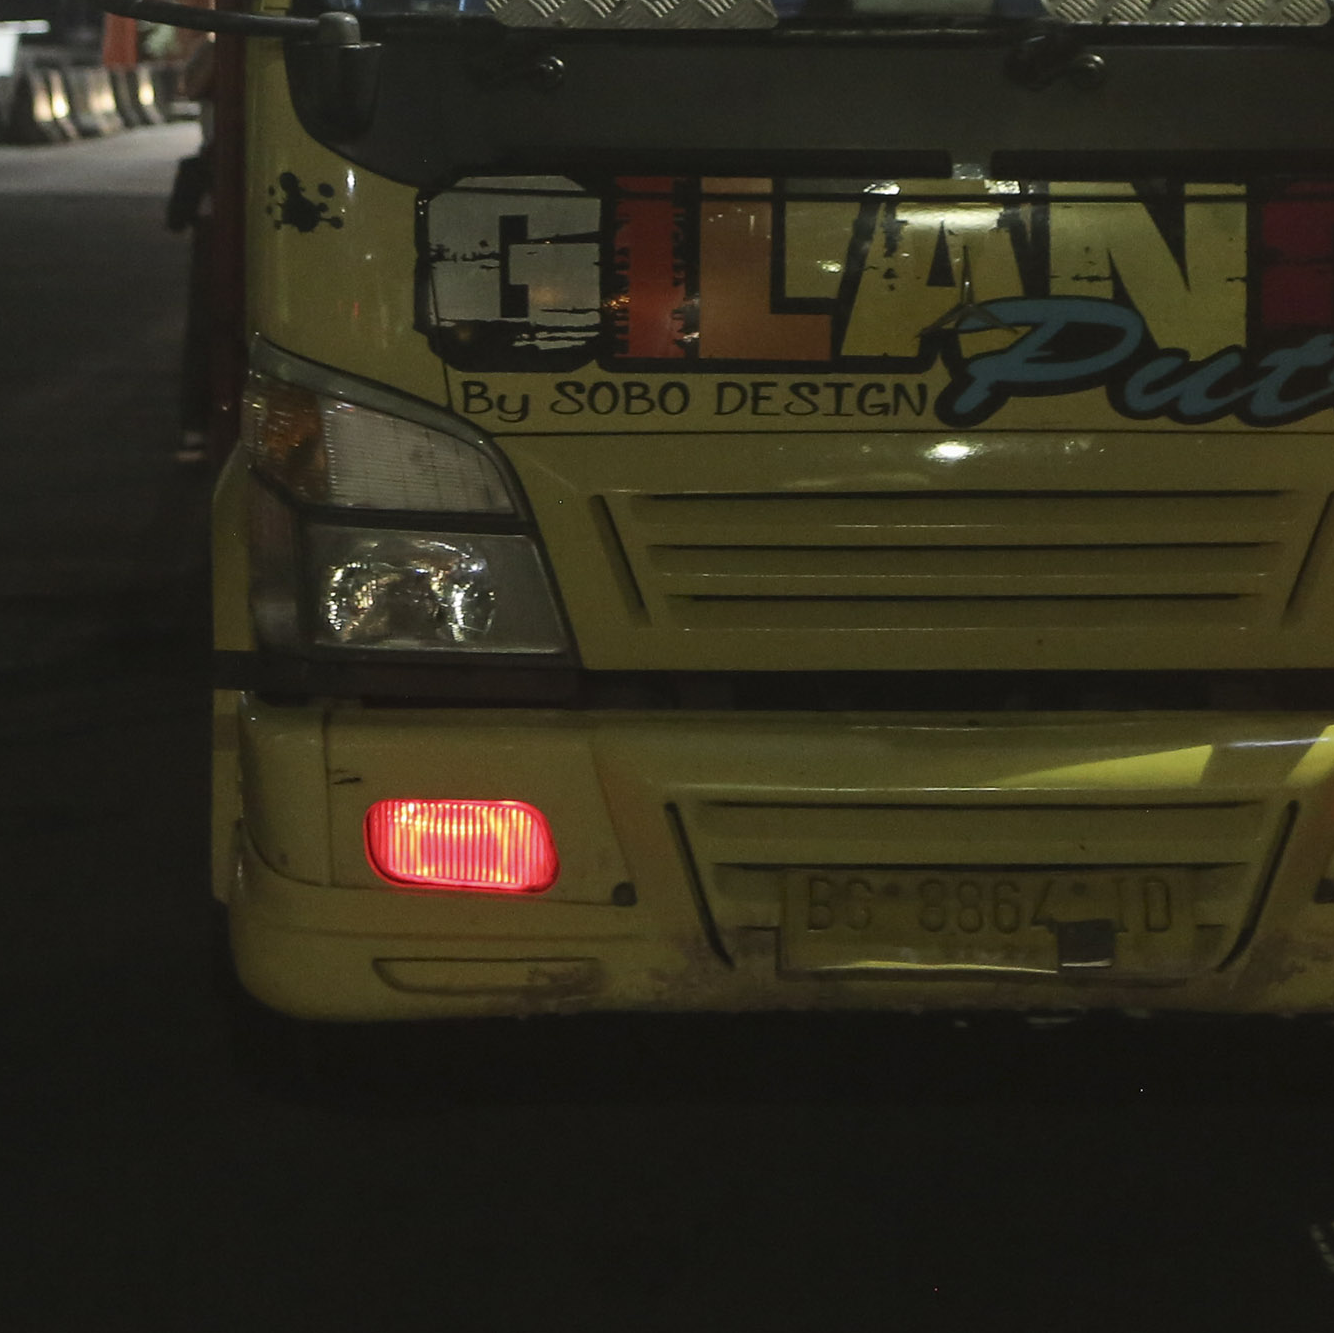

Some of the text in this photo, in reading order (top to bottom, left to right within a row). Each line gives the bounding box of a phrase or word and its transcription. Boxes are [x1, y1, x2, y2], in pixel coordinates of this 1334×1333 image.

[461, 379, 929, 422] By SOBO DESIGN
